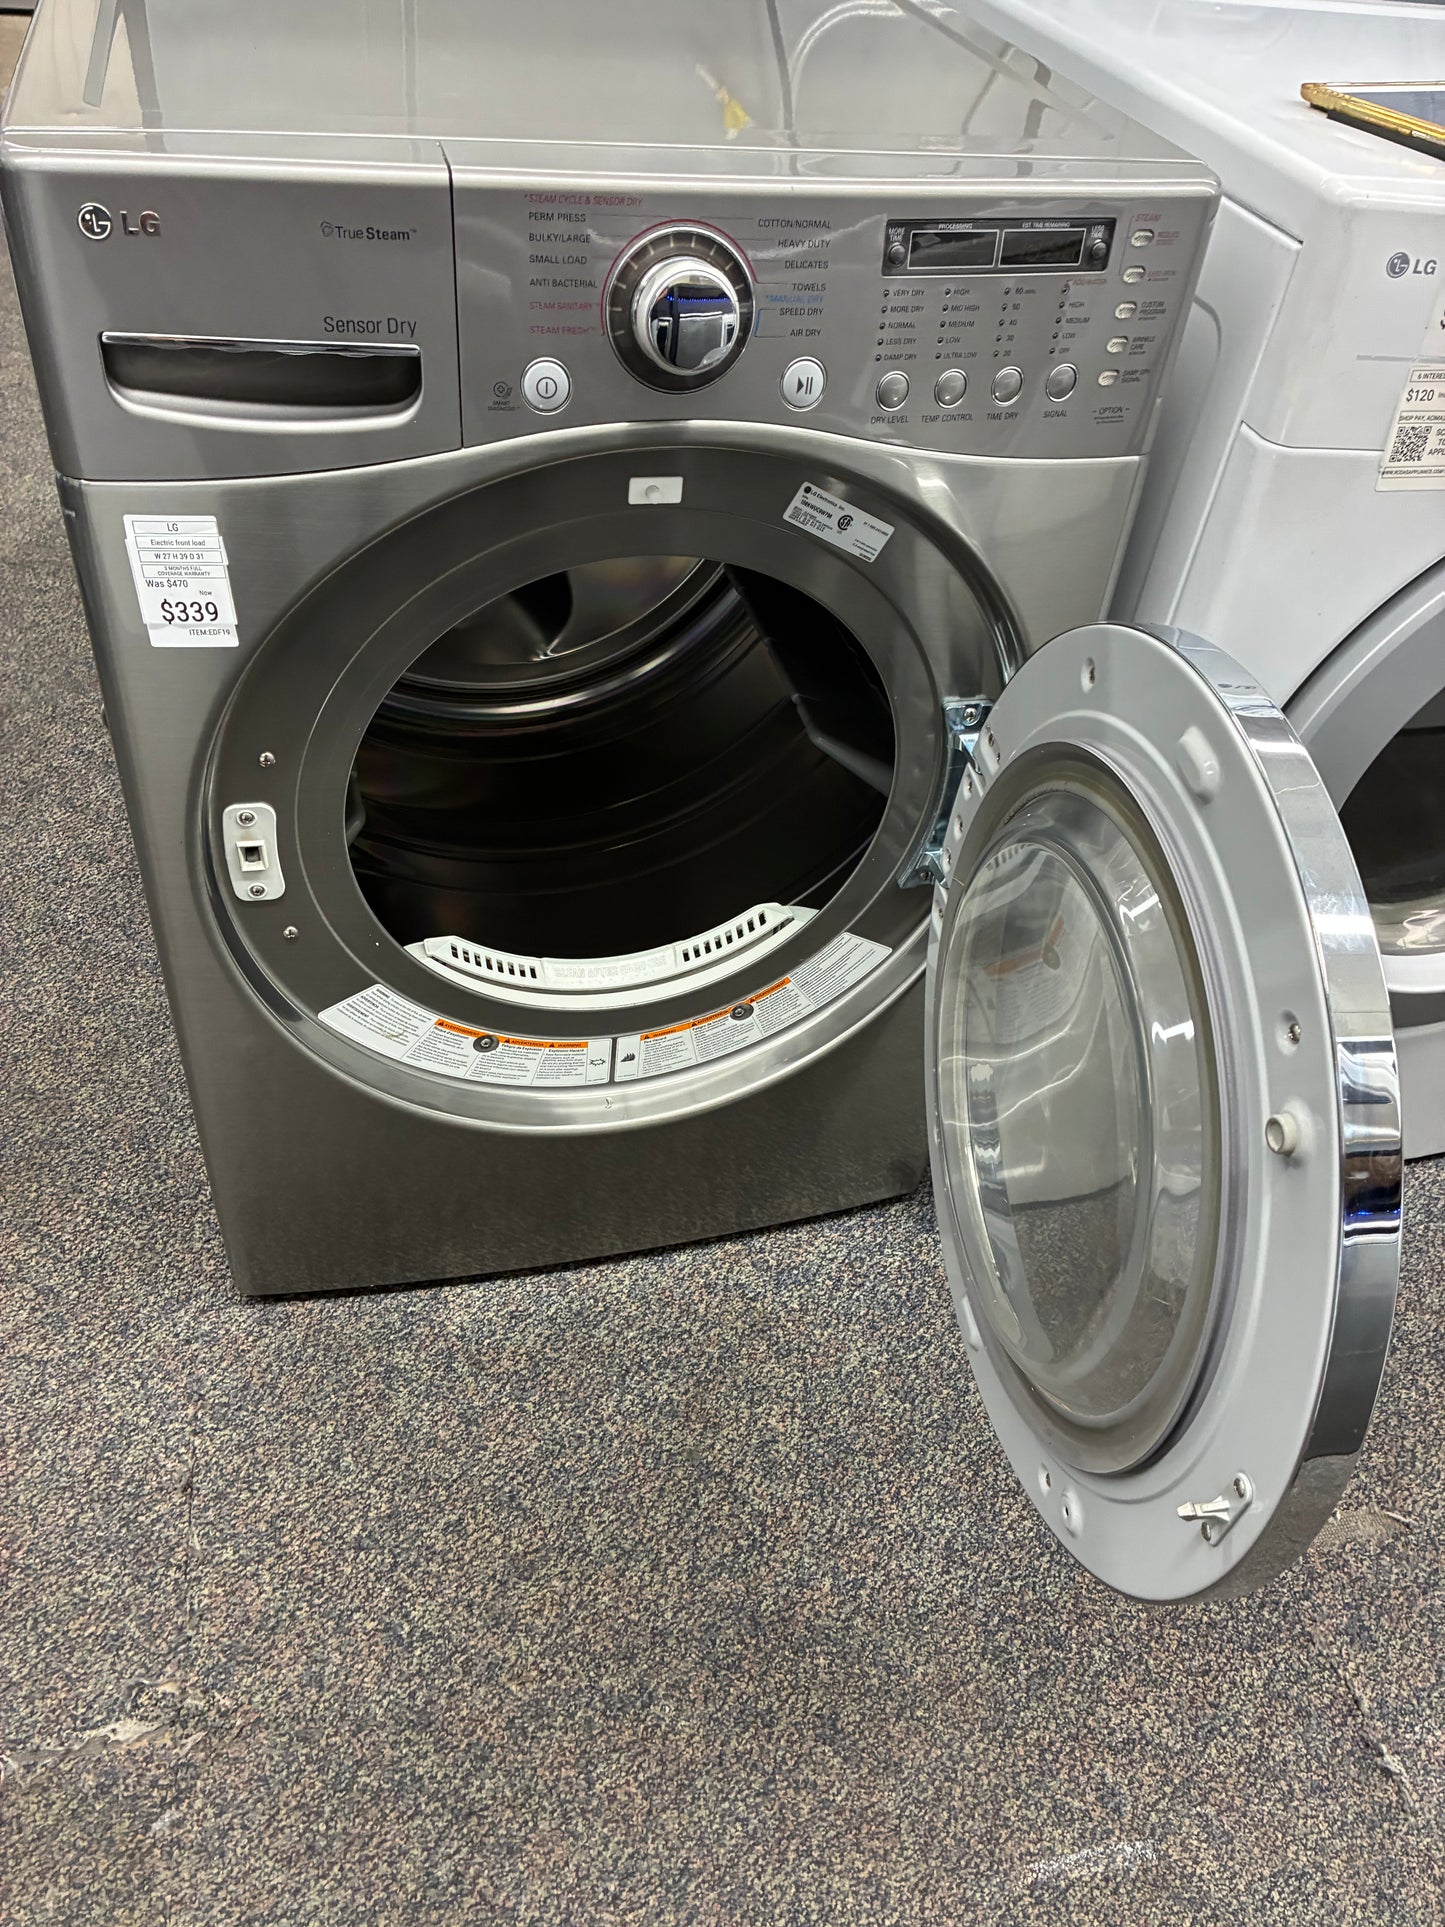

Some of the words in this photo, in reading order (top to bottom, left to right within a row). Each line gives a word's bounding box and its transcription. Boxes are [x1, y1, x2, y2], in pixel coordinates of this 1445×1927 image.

[528, 211, 554, 222] PERM
[557, 212, 586, 223] PRESS
[120, 210, 161, 237] LG
[757, 218, 832, 229] COTTON/NORMAL
[528, 233, 591, 244] BULKY/LARGE
[777, 239, 806, 249] HEAVY
[808, 239, 831, 249] DUTY
[529, 254, 559, 264] SMALL
[562, 255, 588, 265] LOAD
[784, 260, 829, 269] DELICATES
[1412, 259, 1438, 276] LG
[529, 278, 550, 287] ANTI
[552, 279, 598, 289] BACTERIAL
[792, 282, 826, 291] TOWELS
[893, 289, 910, 297] VERY
[911, 289, 925, 297] DRY
[953, 288, 970, 296] HIGH
[779, 307, 806, 316] SPEED
[807, 308, 824, 316] DRY
[889, 305, 909, 313] MORE
[911, 305, 925, 313] DRY
[323, 316, 382, 334] Sensor
[386, 317, 417, 338] Dry
[887, 321, 916, 329] NORMAL
[948, 320, 975, 328] MEDIUM
[529, 325, 560, 335] STEAM
[789, 328, 803, 337] AIR
[805, 328, 822, 337] DRY
[903, 337, 917, 345] DRY
[945, 336, 961, 344] LOW
[904, 353, 918, 361] DRY
[1405, 387, 1435, 403] $120
[1042, 409, 1068, 419] SIGNAL
[1099, 406, 1123, 415] OPTION
[870, 415, 887, 424] DRY
[887, 414, 910, 424] LEVEL
[921, 414, 941, 423] TEMP
[941, 413, 973, 423] CONTROL
[986, 412, 1003, 421] TIME
[1004, 411, 1019, 420] DRY
[166, 522, 179, 532] LG
[145, 580, 165, 588] Was
[167, 579, 188, 589] $470
[160, 598, 219, 625] $339
